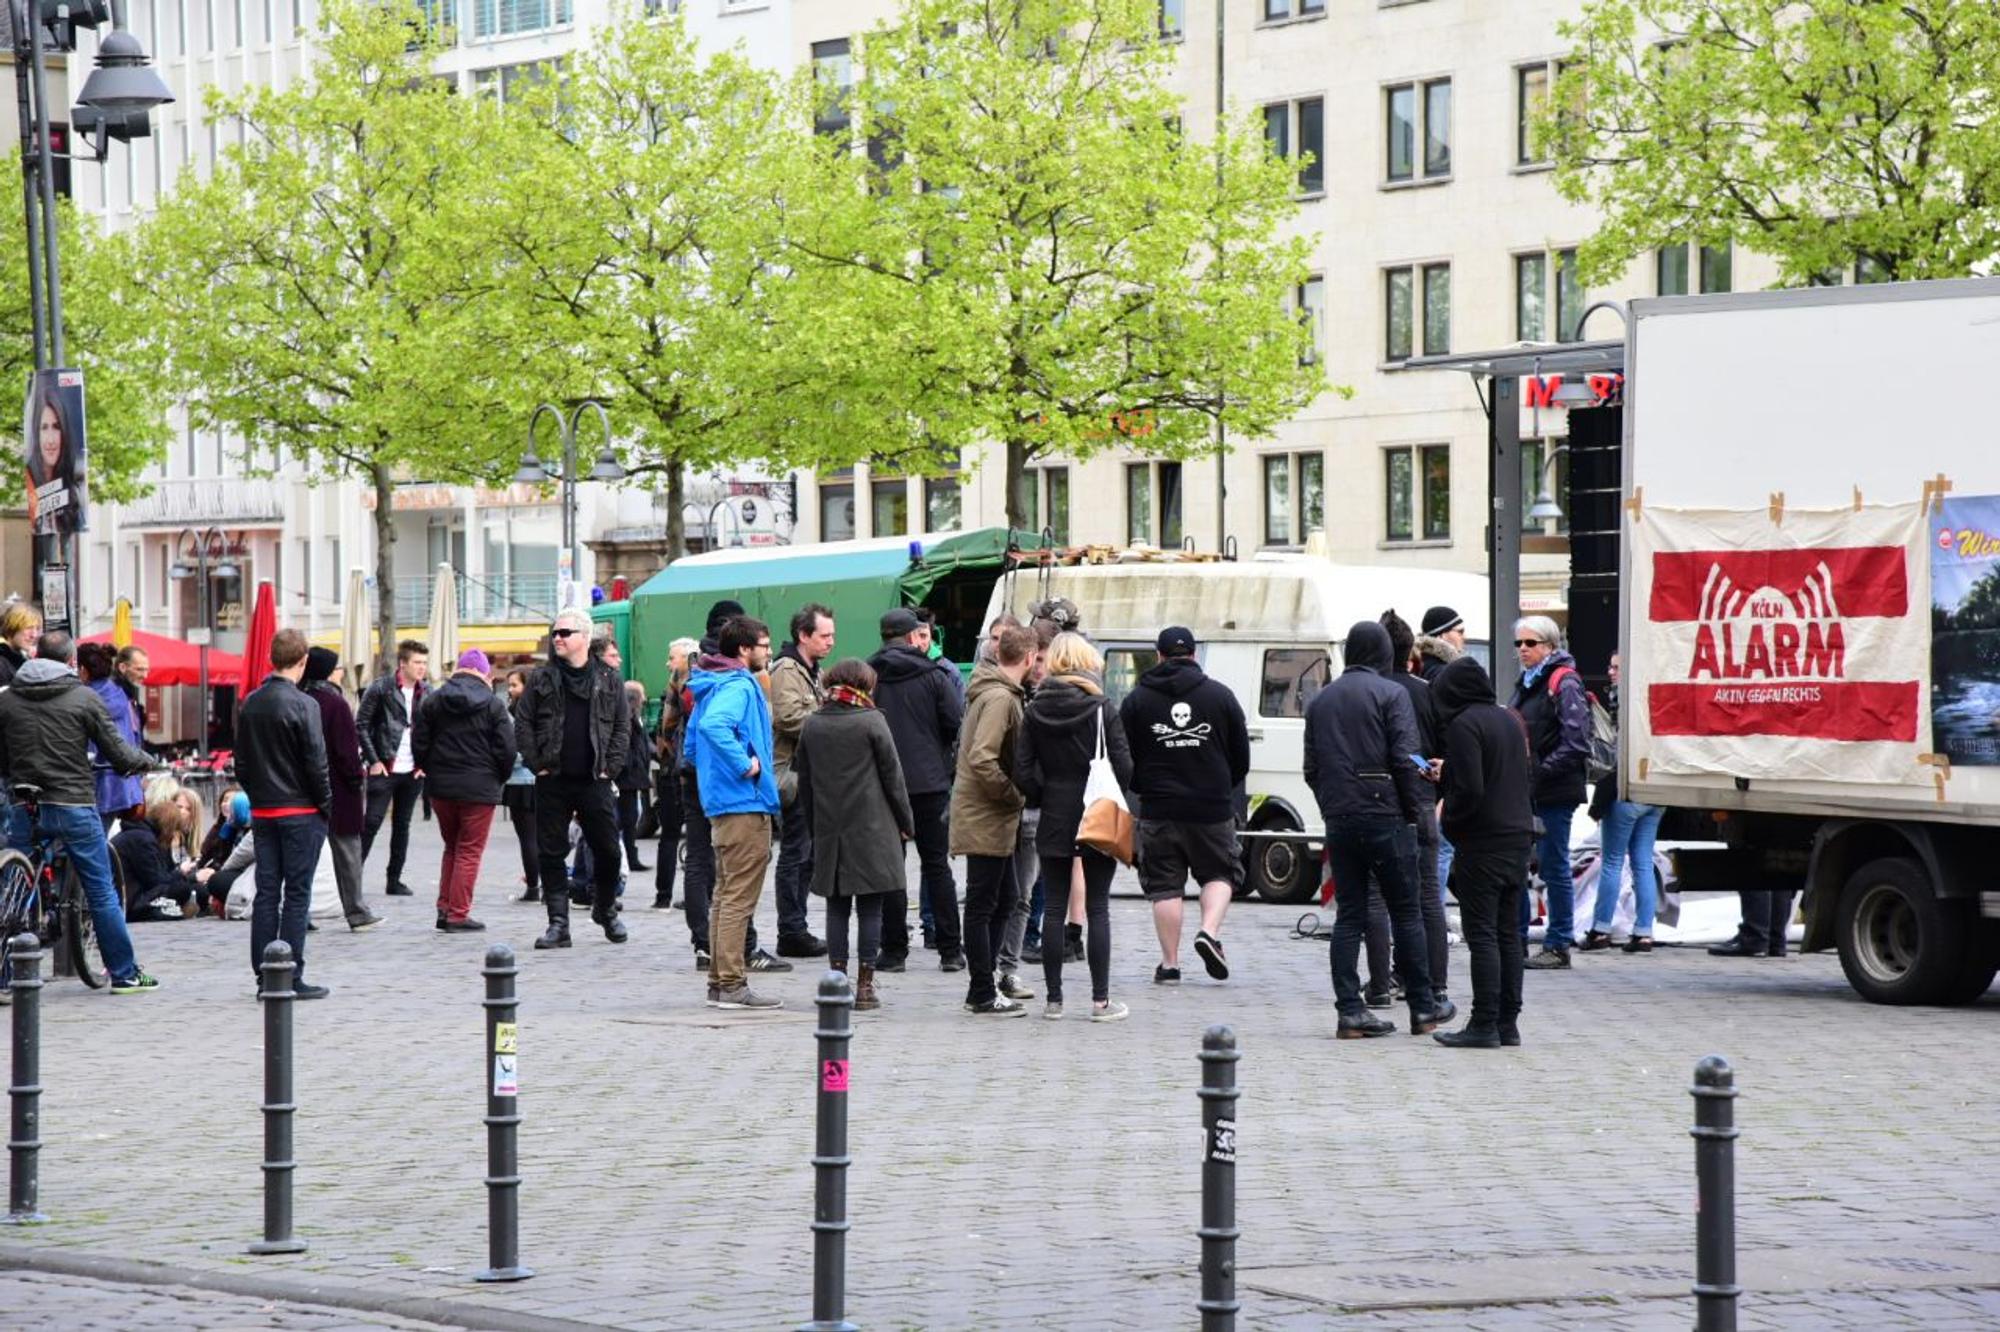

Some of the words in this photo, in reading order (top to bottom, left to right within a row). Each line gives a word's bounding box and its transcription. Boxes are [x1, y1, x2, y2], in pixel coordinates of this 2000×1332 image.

[1751, 598, 1783, 618] KÖLN
[1688, 621, 1845, 679] ALARM
[1714, 689, 1745, 704] AKTIV
[1747, 687, 1780, 703] GEGEN
[1782, 686, 1822, 702] RECHTS
